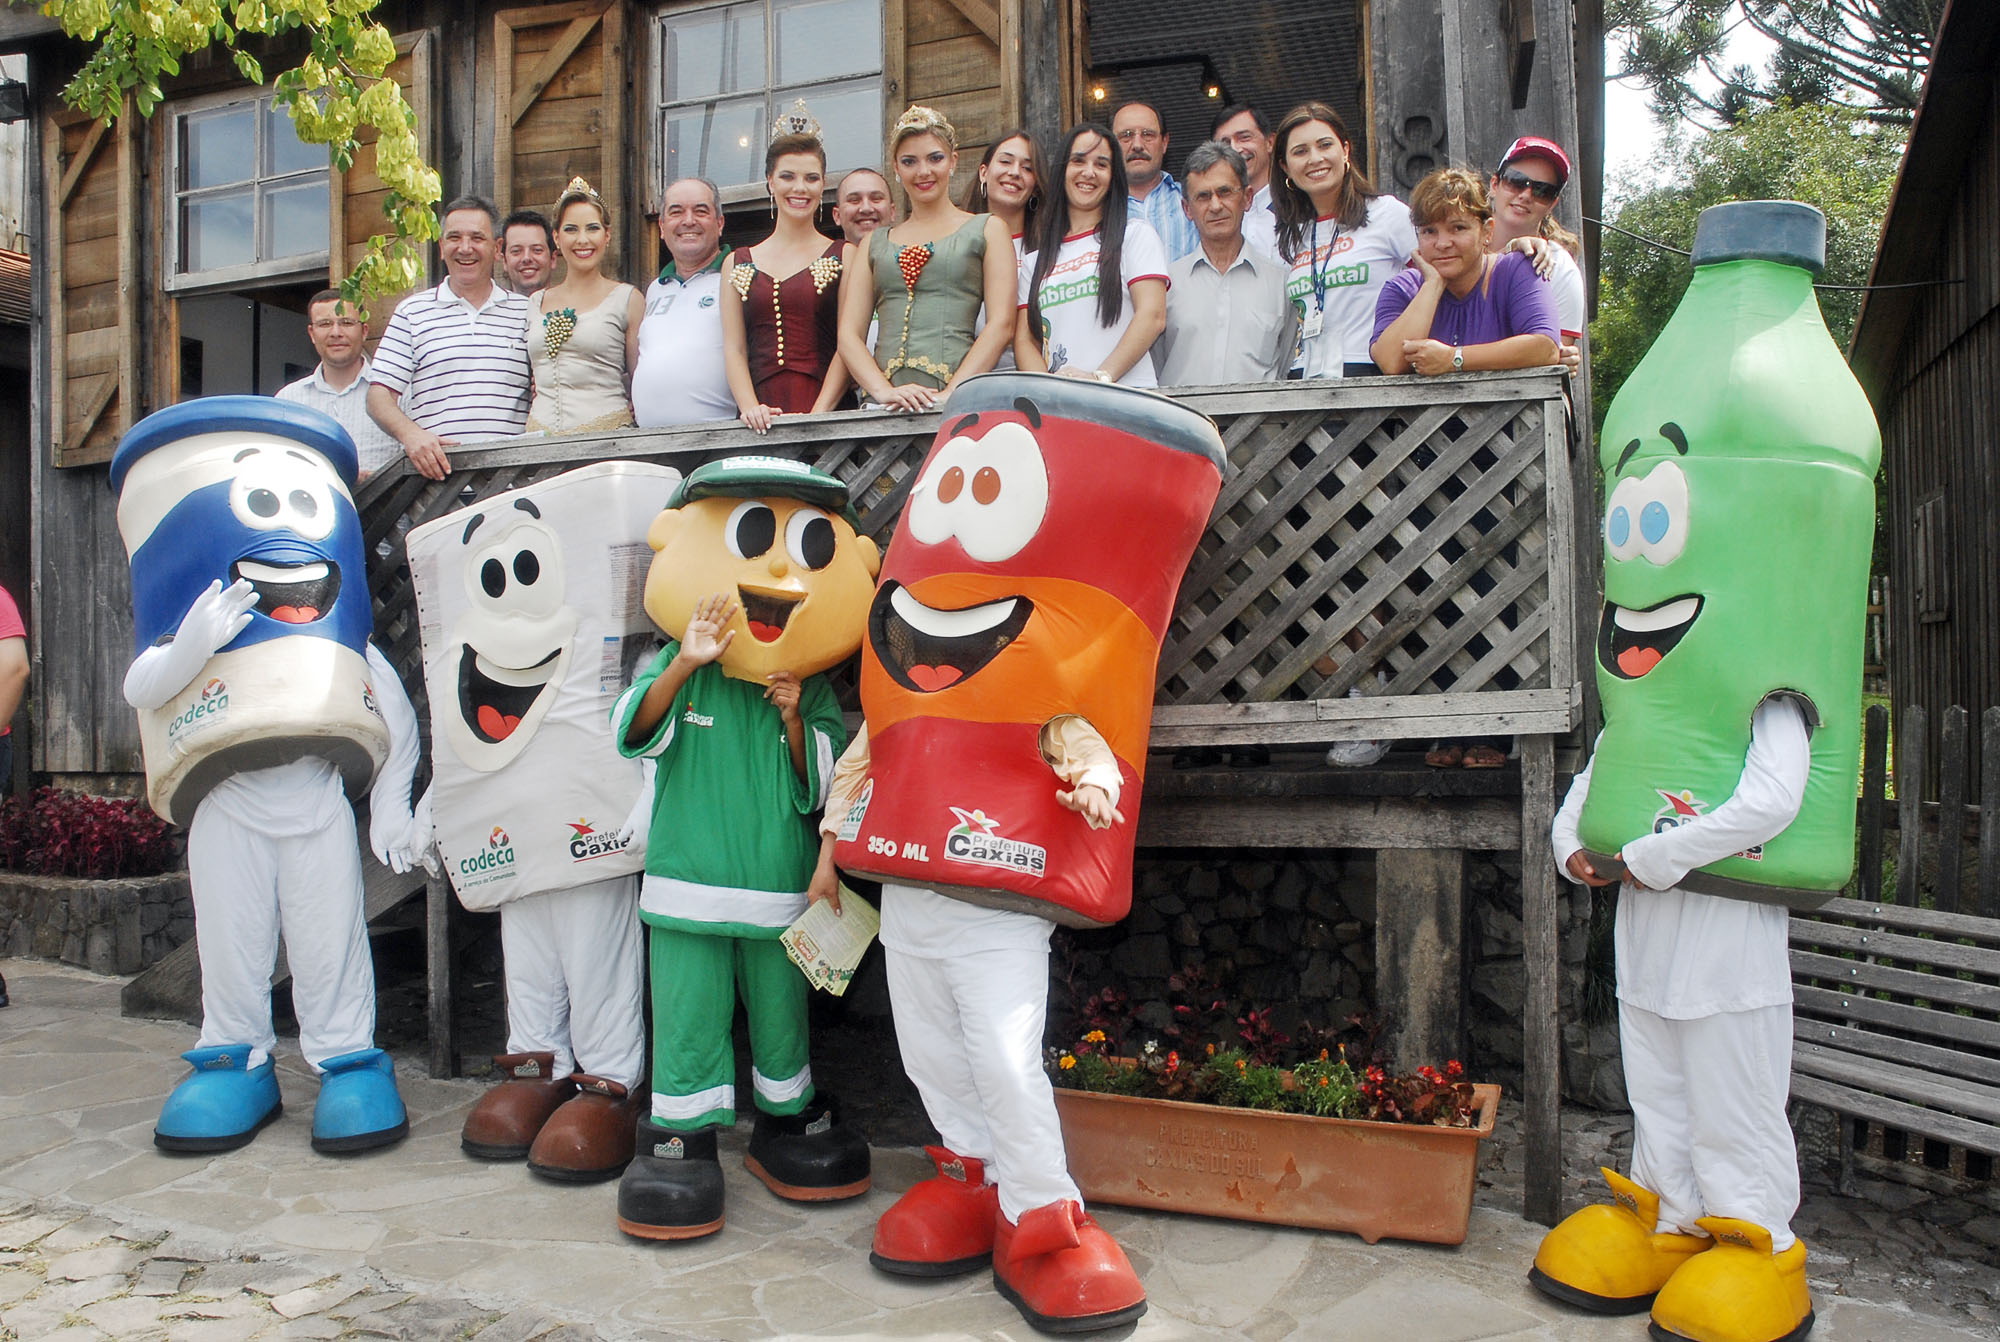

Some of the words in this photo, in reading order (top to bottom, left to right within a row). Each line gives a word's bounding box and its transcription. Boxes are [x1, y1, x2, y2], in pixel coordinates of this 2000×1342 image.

[169, 695, 228, 736] codeca
[570, 834, 632, 858] Caxia
[867, 836, 898, 857] 350
[902, 842, 930, 863] ML
[949, 834, 1044, 870] Caxias
[973, 835, 1045, 859] Prefeitura
[461, 848, 514, 874] codeca
